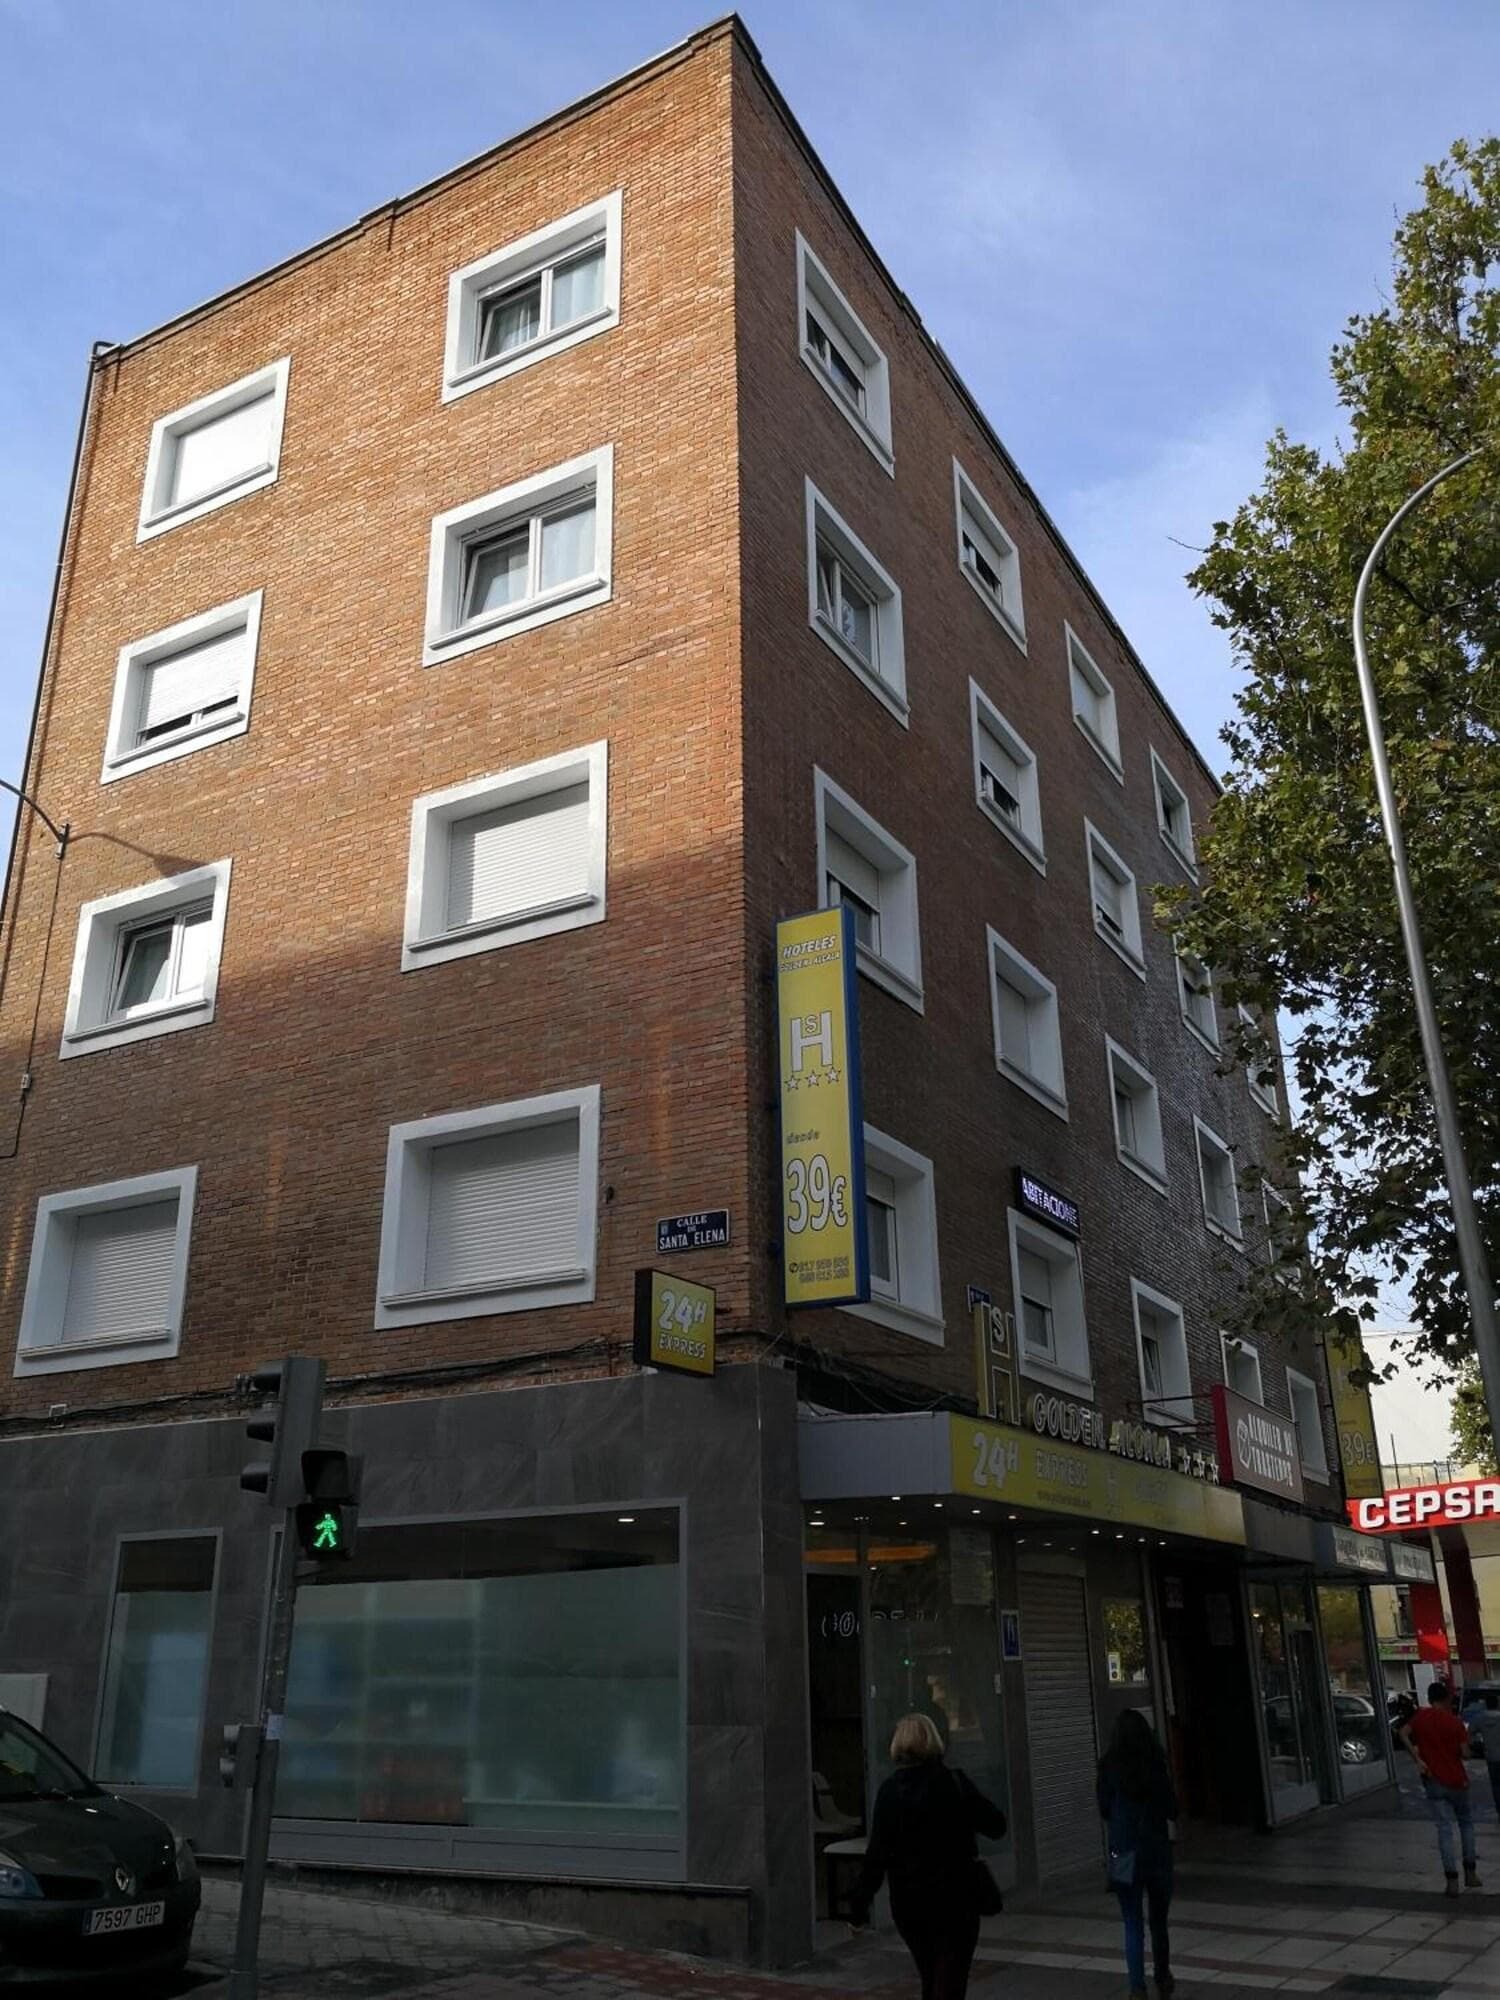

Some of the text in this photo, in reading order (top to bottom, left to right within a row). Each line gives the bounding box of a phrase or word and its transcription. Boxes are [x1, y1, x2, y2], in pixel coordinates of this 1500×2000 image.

[783, 936, 836, 959] HOTELES
[786, 1154, 848, 1234] 39€
[677, 1215, 707, 1228] CALLE
[660, 1228, 725, 1250] SANTA ELENA
[659, 1289, 708, 1334] 24H
[659, 1333, 707, 1360] EXPRESS
[1031, 1392, 1107, 1451] GOLDEN
[1359, 1483, 1500, 1529] CEPSA
[94, 1904, 160, 1932] 7597 GHP
